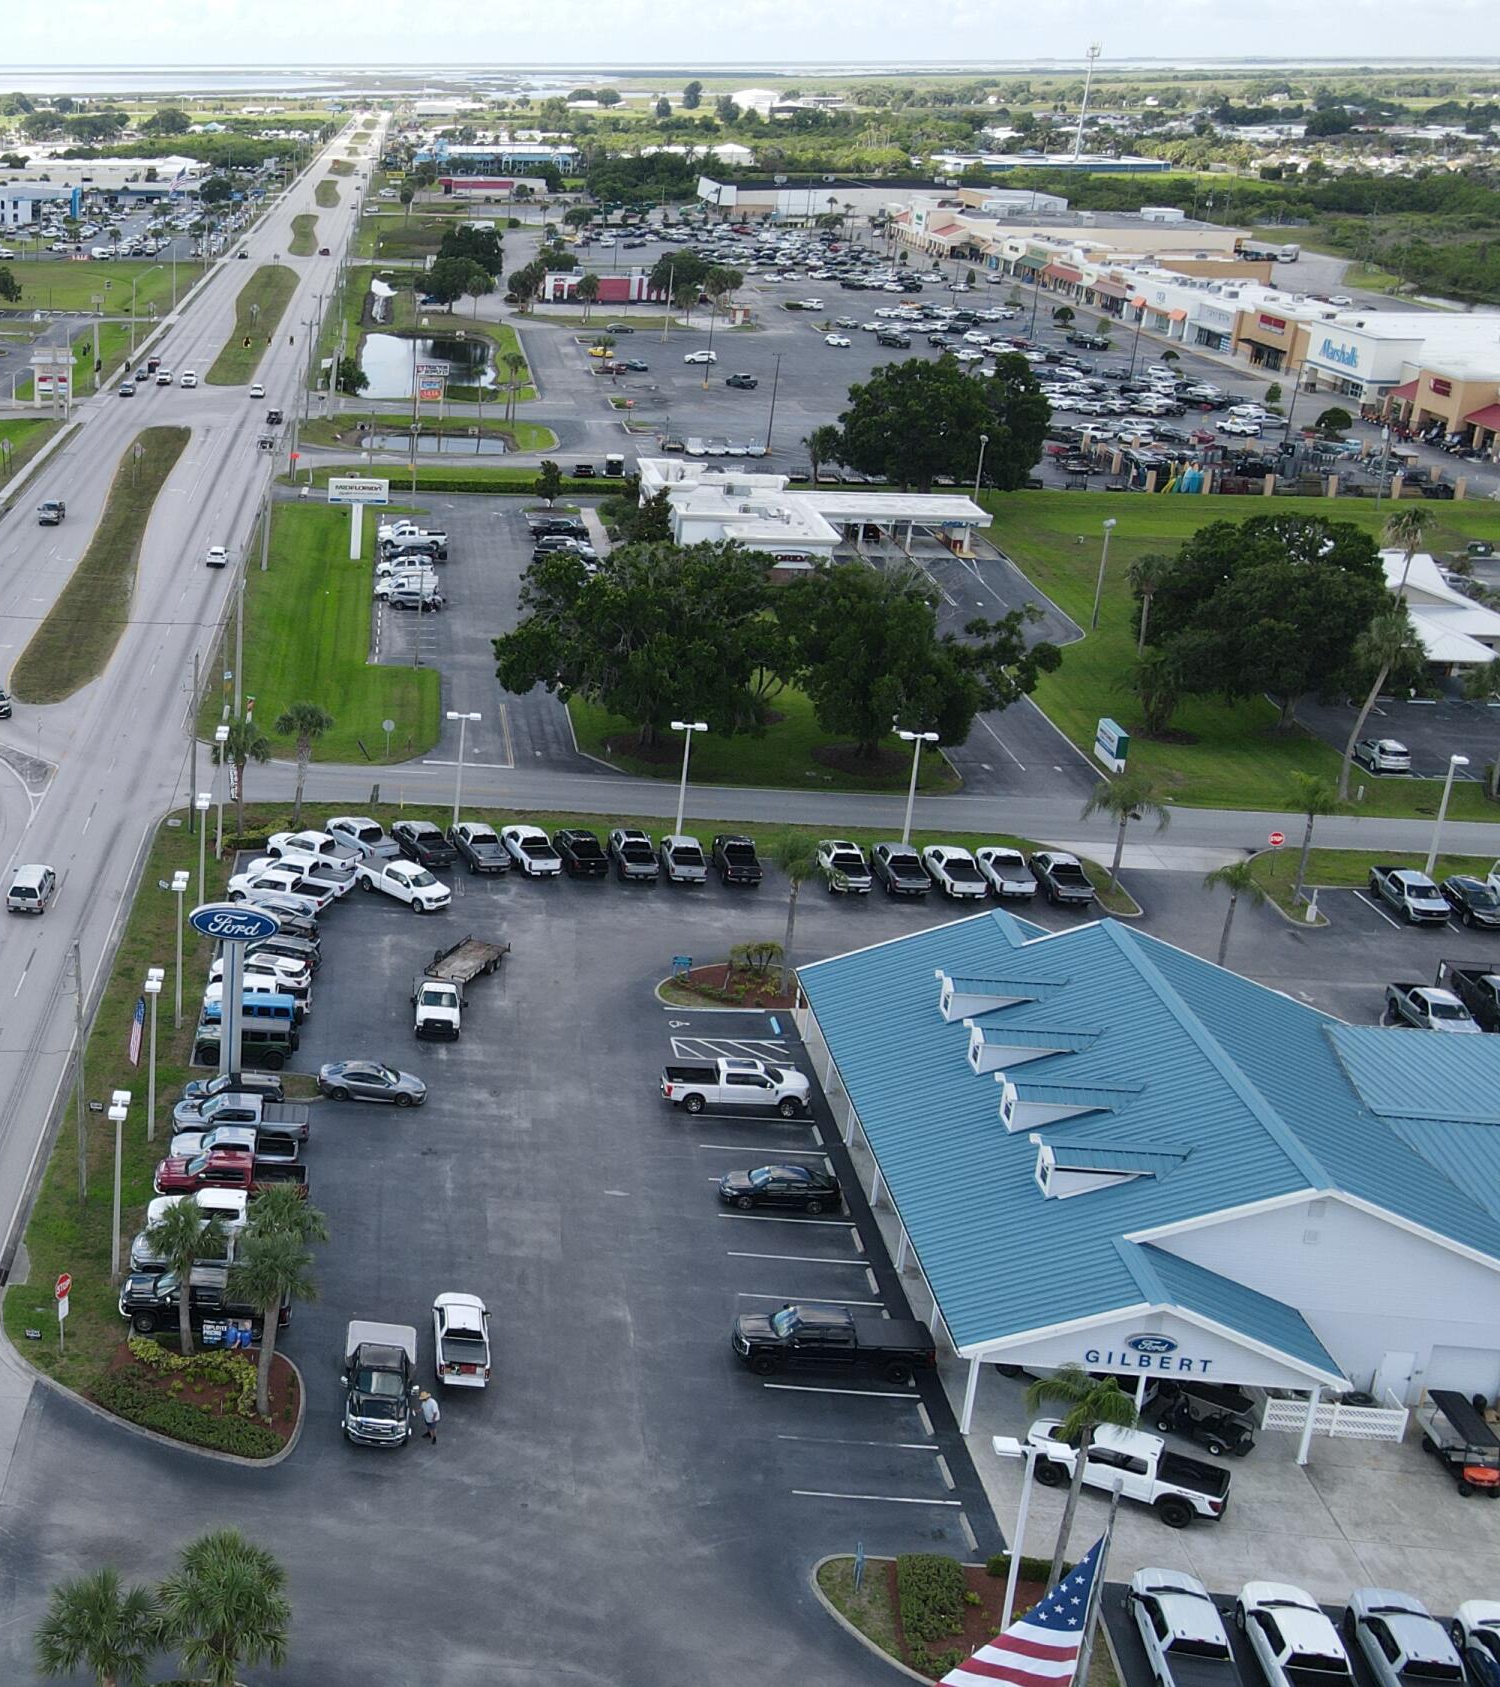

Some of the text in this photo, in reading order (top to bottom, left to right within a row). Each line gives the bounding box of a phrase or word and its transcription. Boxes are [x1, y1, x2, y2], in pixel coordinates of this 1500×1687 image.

[1320, 338, 1359, 369] Marshalls
[208, 913, 262, 936] Ford
[56, 1279, 70, 1295] STOP
[1138, 1339, 1169, 1352] Ford
[1085, 1349, 1213, 1373] GILBERT
